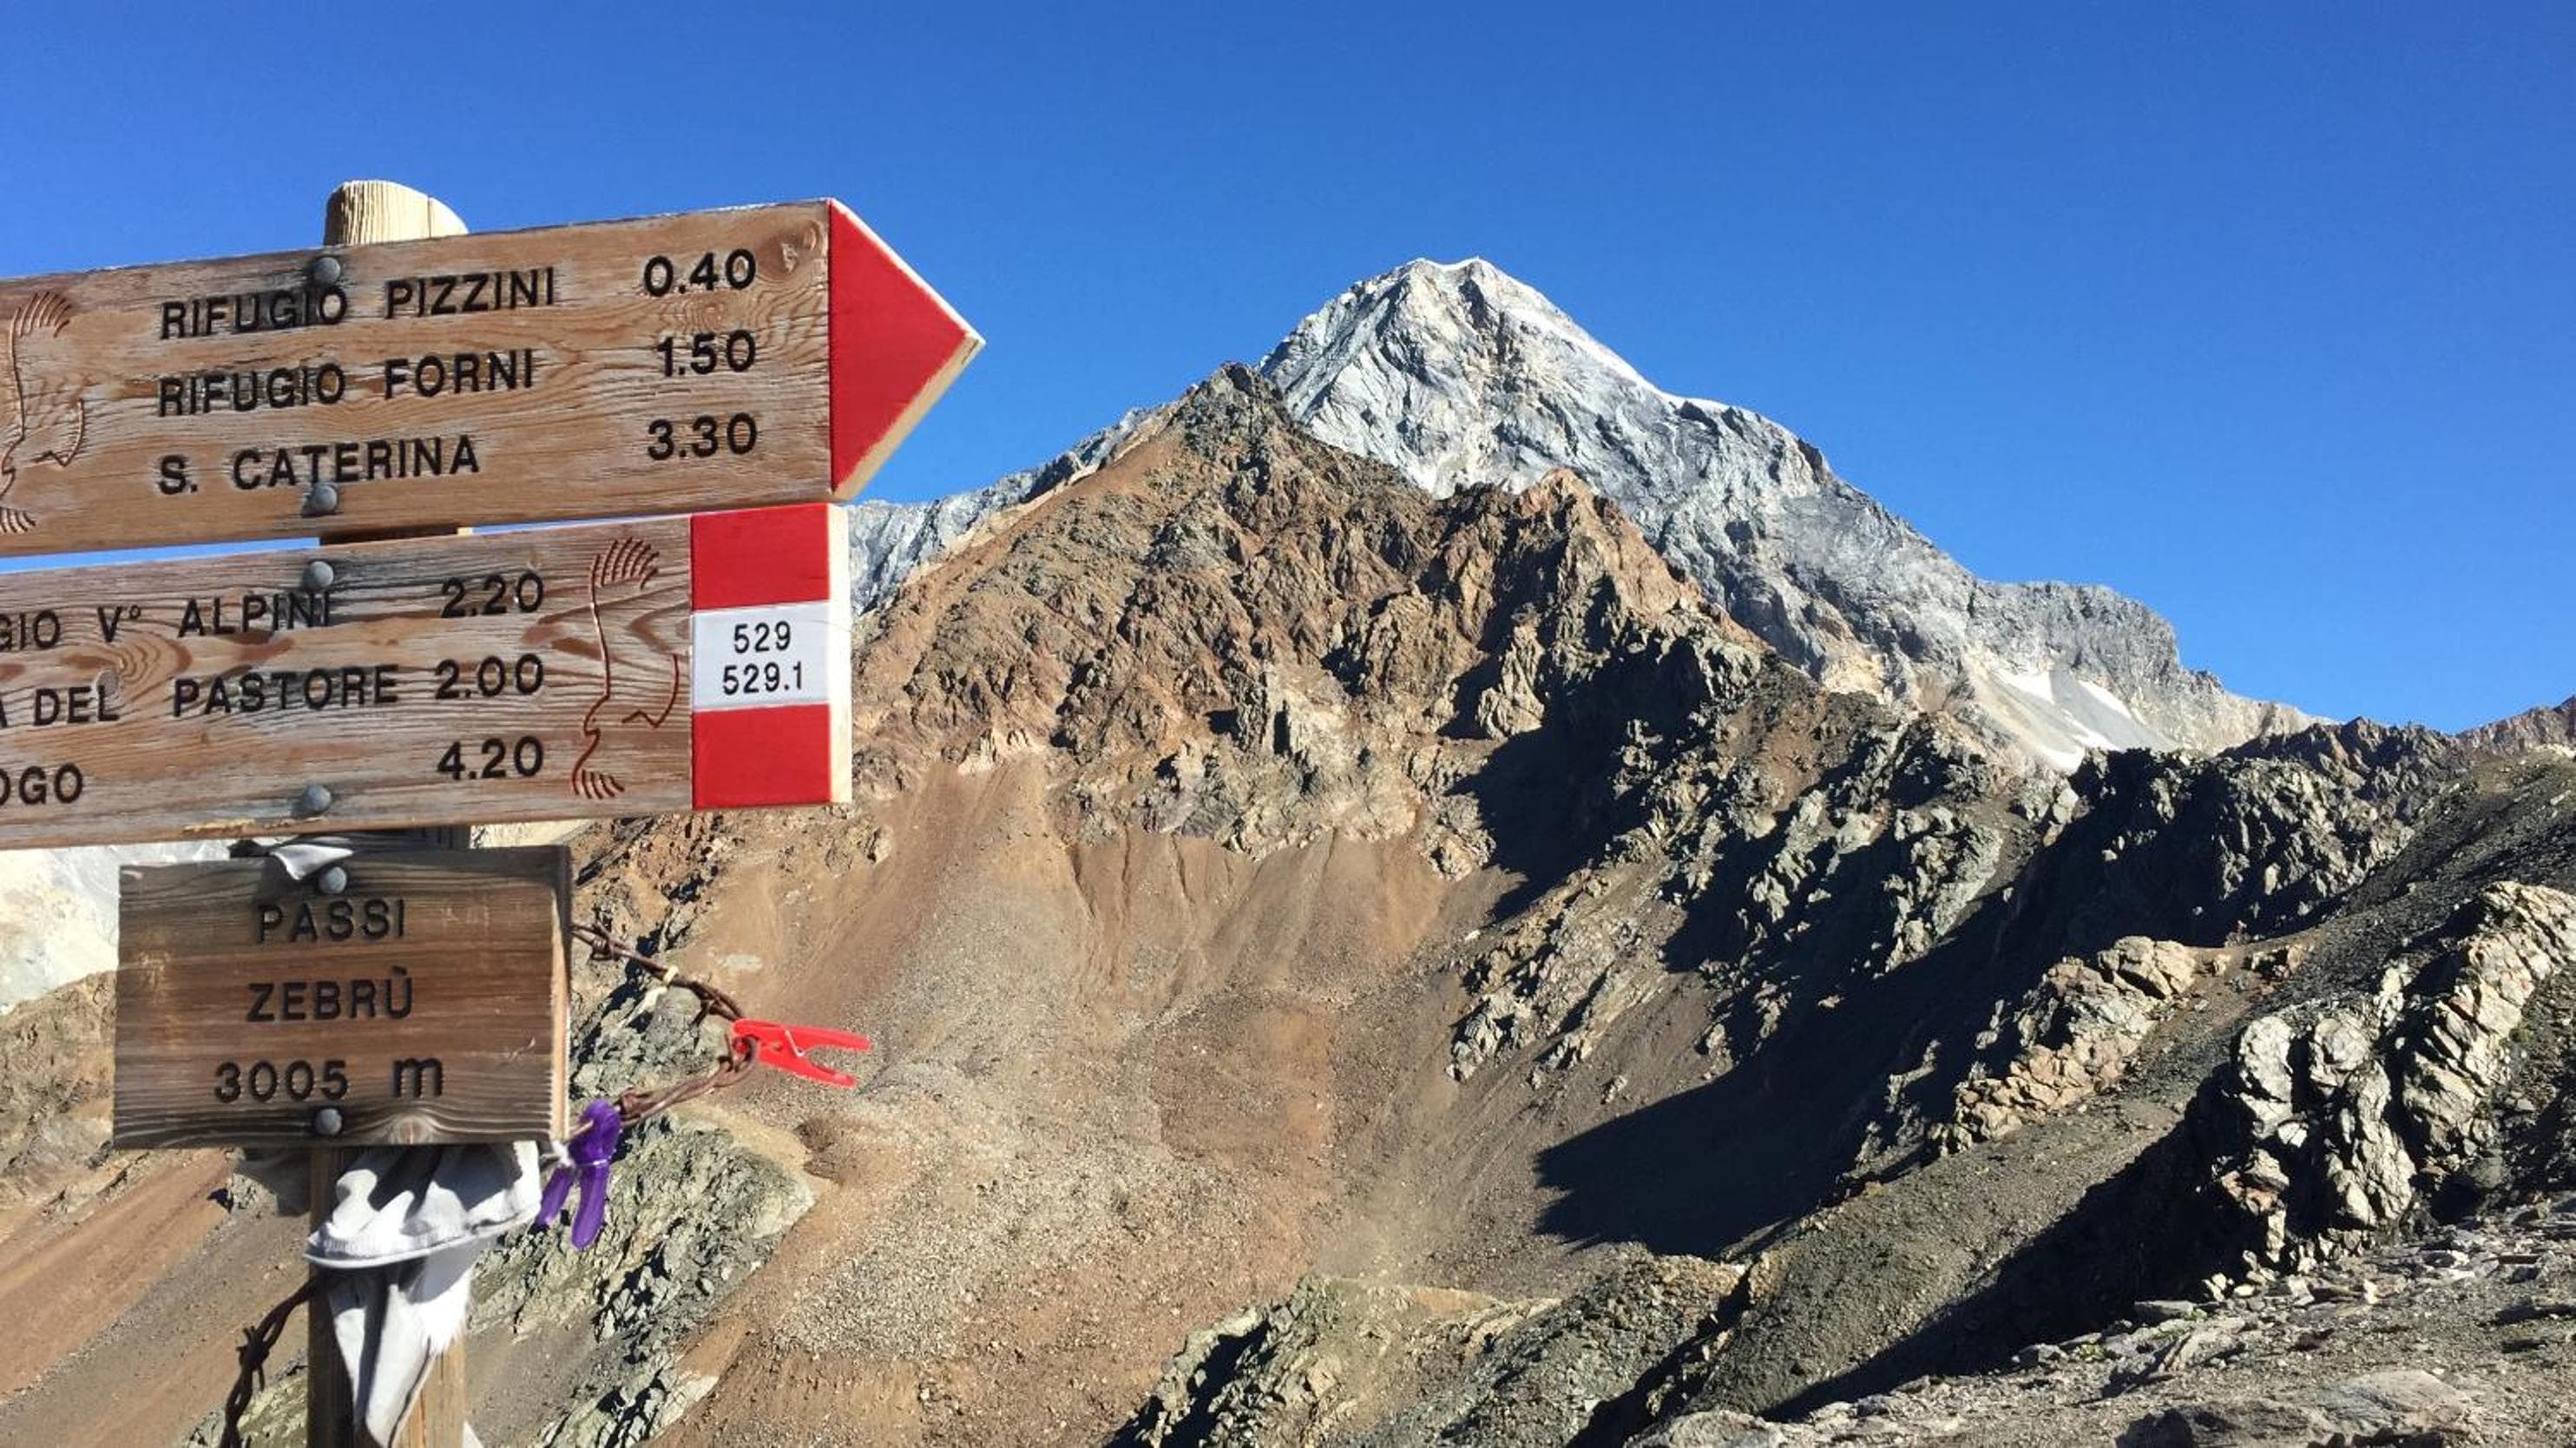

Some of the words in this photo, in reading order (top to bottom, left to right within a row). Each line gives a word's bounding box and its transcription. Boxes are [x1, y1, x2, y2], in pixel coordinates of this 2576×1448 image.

[161, 285, 347, 340] RIFUGIO
[385, 266, 555, 319] PIZZINI
[644, 247, 757, 298] 0.40
[158, 363, 345, 417] RIFUGIO
[384, 348, 533, 399] FORNI
[656, 328, 756, 378] 1.50
[159, 453, 199, 495] S.
[232, 434, 480, 490] CATERINA
[647, 412, 758, 462] 3.30
[178, 591, 332, 638] ALPINI
[440, 573, 545, 618] 2.20
[733, 621, 792, 654] 529
[34, 684, 120, 727] DEL
[174, 663, 399, 717] PASTORE
[435, 653, 545, 699] 2.00
[721, 661, 804, 694] 529.1
[437, 735, 544, 780] 4.20
[260, 898, 405, 944] PASSI
[246, 965, 414, 1023] ZEBRÙ
[214, 1059, 348, 1103] 3005
[392, 1056, 444, 1097] m
